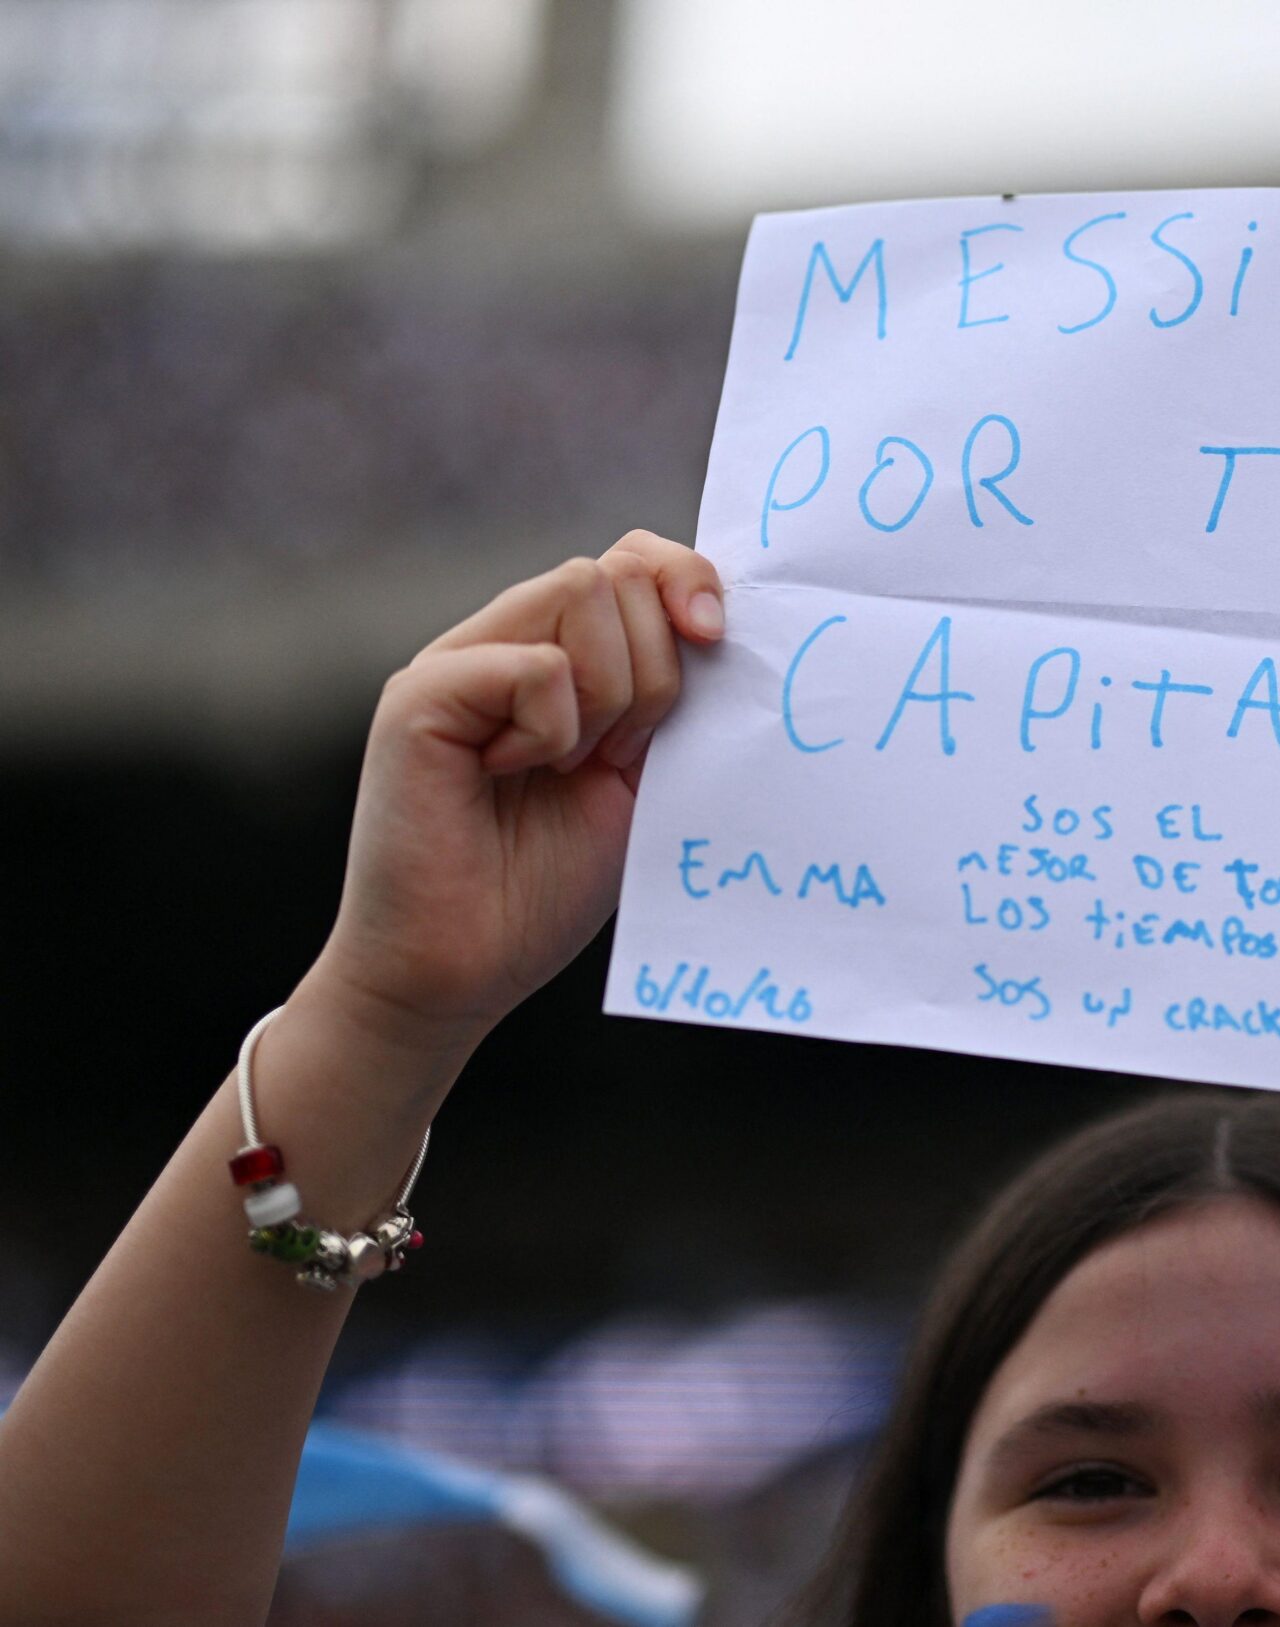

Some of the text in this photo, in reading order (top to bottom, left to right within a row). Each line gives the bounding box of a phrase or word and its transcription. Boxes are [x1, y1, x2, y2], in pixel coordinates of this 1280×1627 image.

[760, 413, 1036, 549] POR
[1022, 794, 1225, 843] SOS EL
[677, 837, 888, 910] EMMA
[1131, 853, 1202, 895] DE
[959, 881, 1052, 932] LOS
[973, 961, 1053, 1022] SOS
